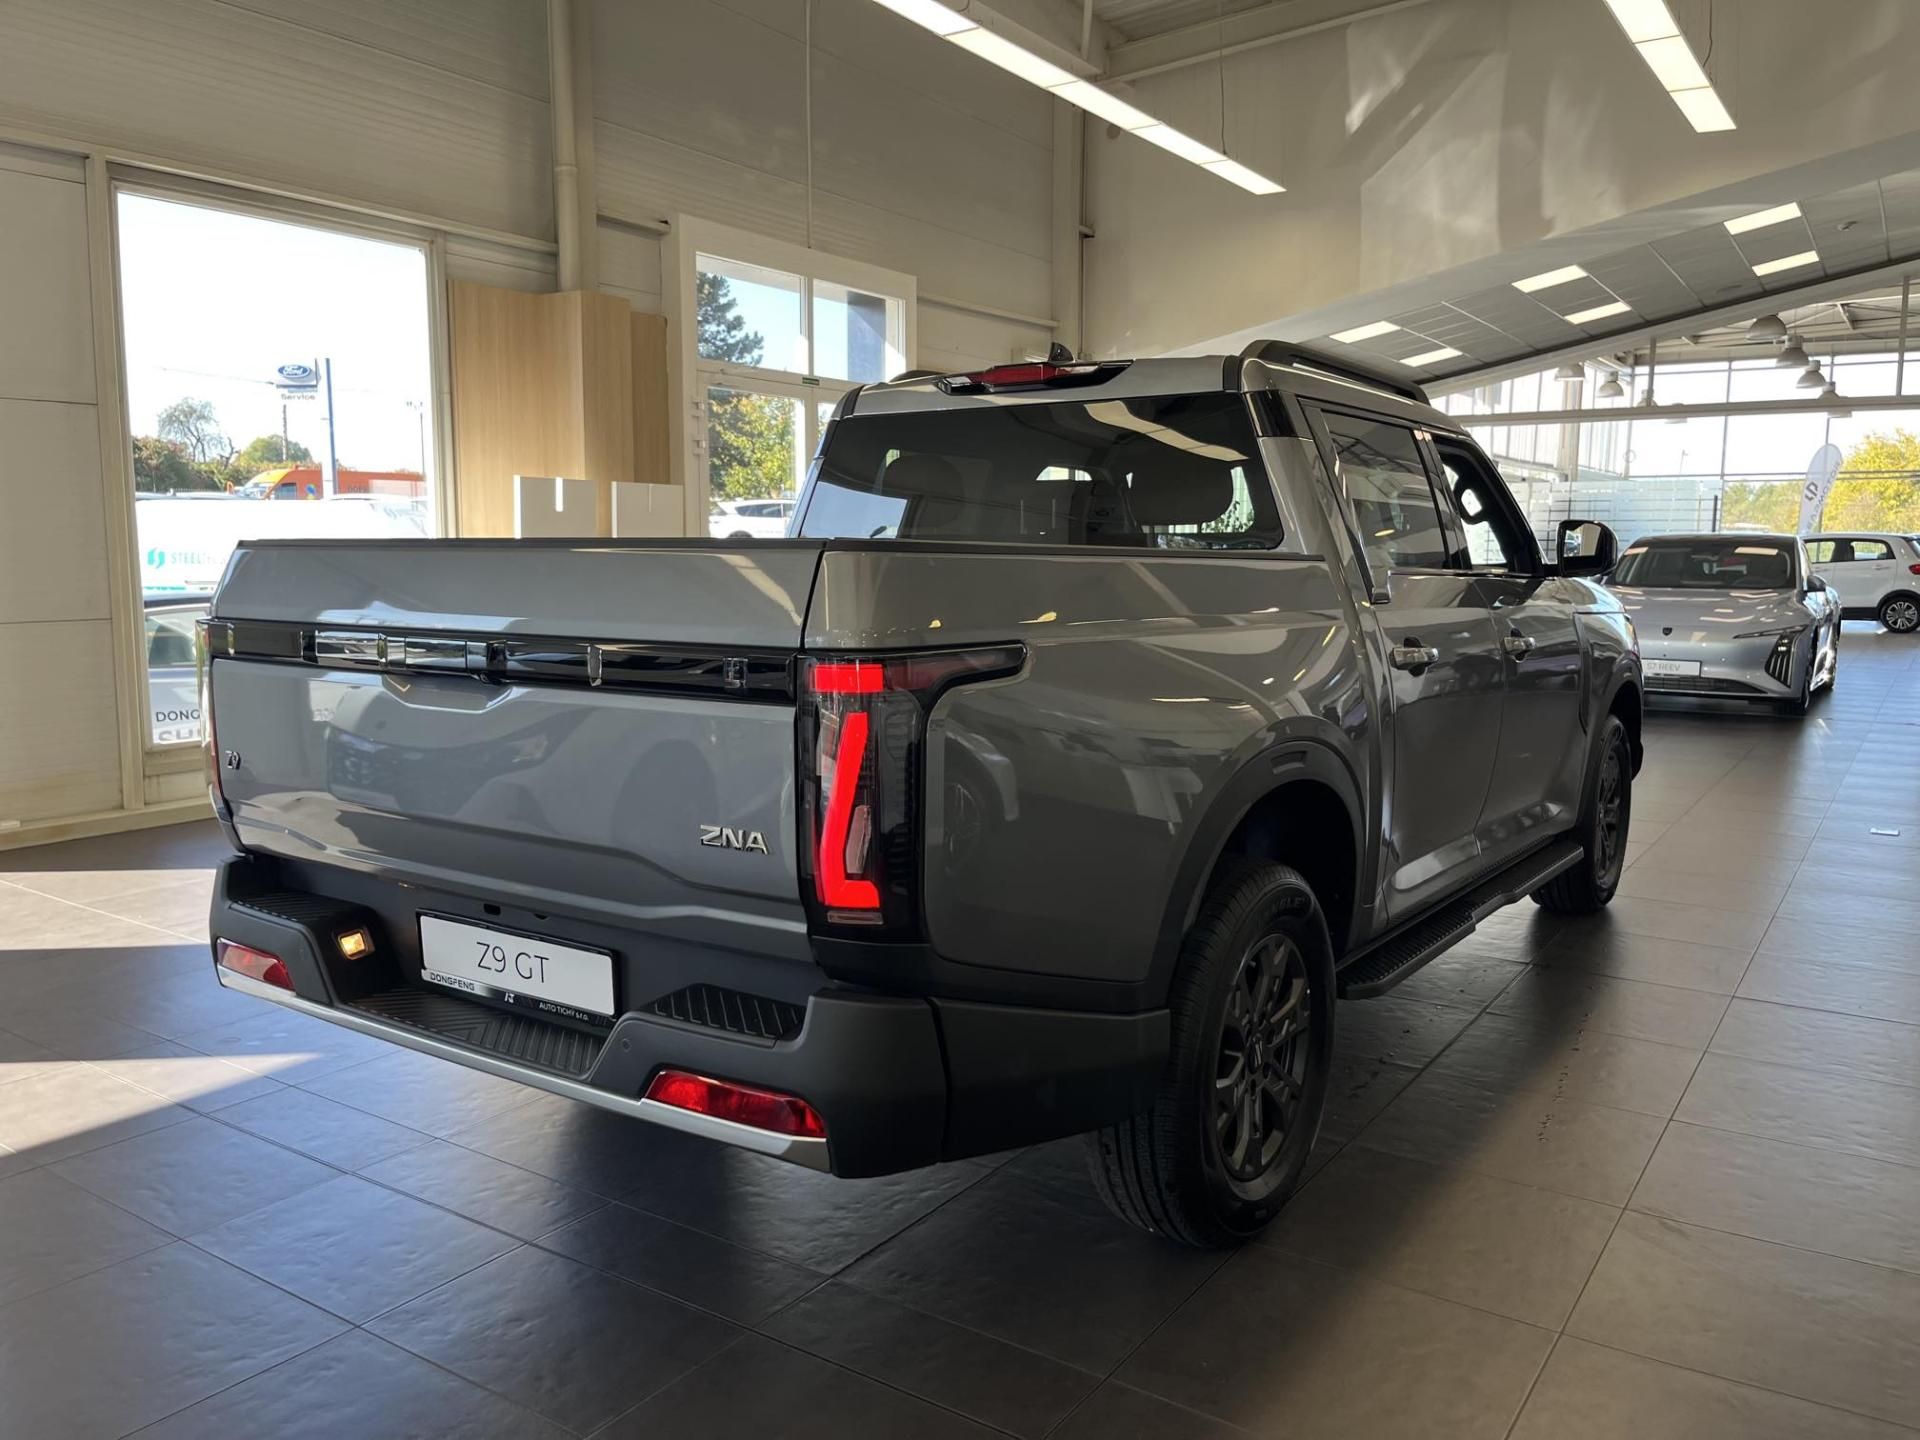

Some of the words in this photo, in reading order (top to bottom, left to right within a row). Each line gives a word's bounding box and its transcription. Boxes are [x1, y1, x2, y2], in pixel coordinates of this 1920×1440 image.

[700, 825, 769, 855] ZNA
[476, 941, 506, 973] Z9
[515, 952, 550, 983] GT
[430, 972, 476, 992] DONGFENG
[539, 1002, 557, 1012] AUTO
